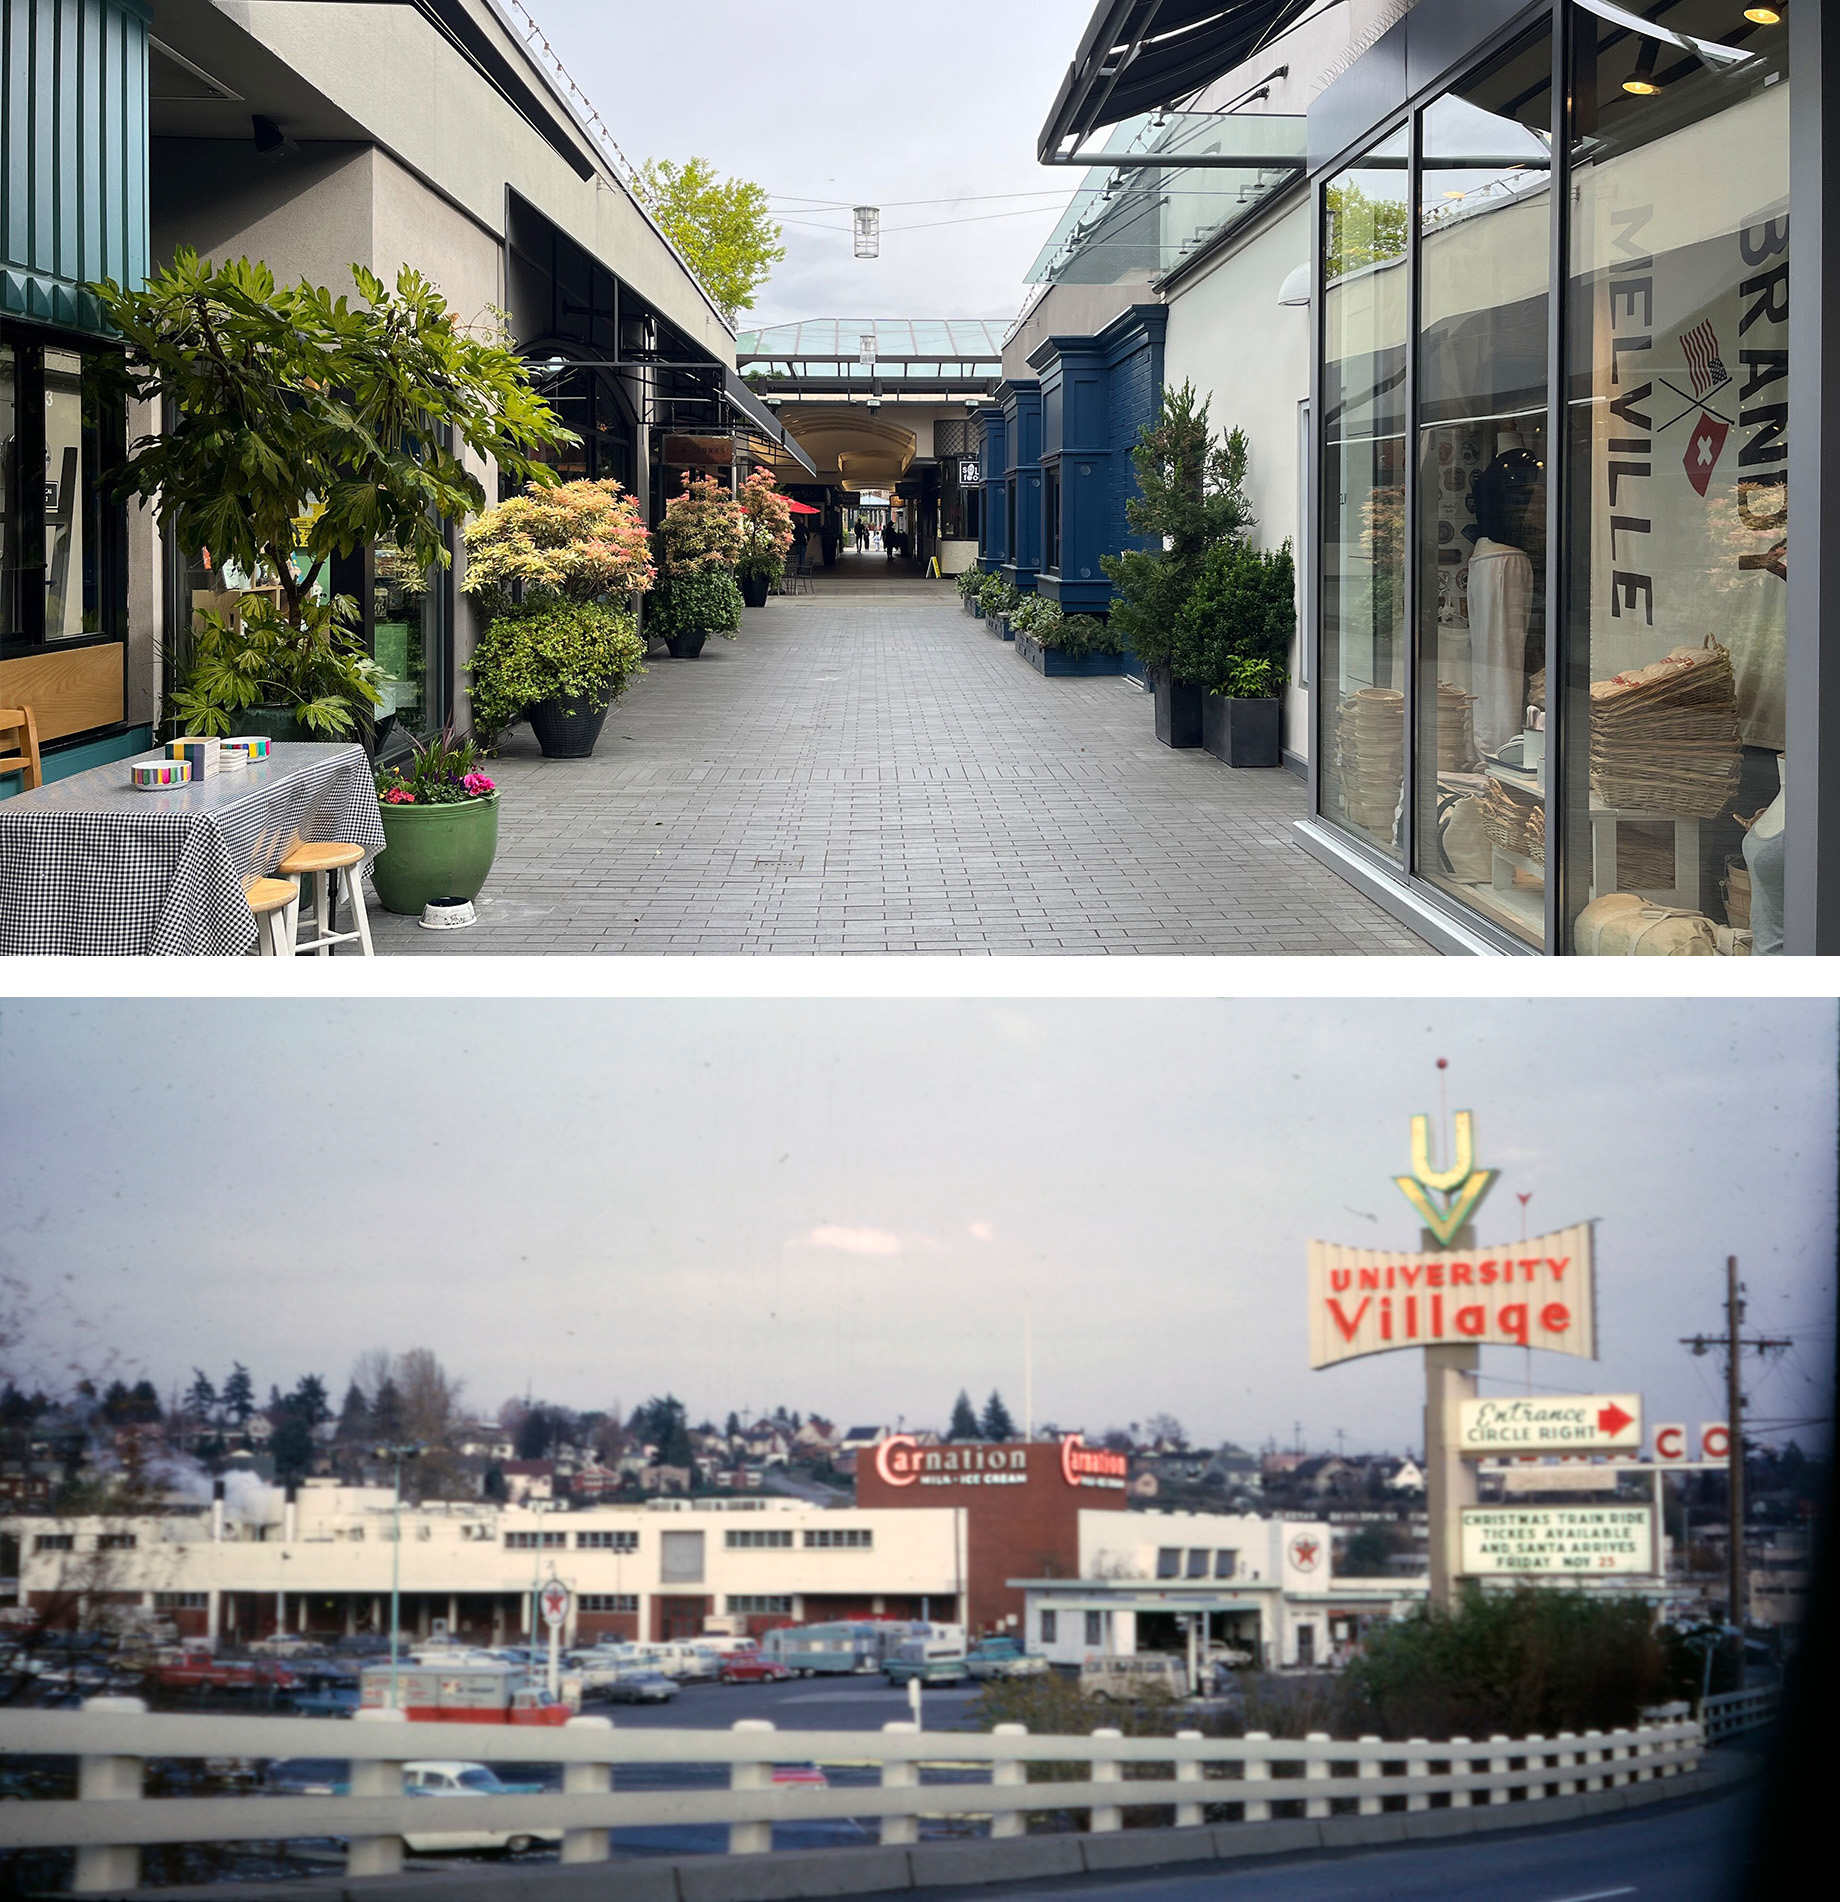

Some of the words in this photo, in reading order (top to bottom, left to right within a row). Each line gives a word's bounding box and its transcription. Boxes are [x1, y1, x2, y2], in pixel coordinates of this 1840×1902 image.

[1738, 197, 1789, 583] BRANDY
[1608, 204, 1654, 626] MELVILLE
[1329, 1256, 1571, 1292] UNIVERSITY
[1325, 1294, 1572, 1346] Village
[1475, 1401, 1587, 1428] Entrance
[1467, 1427, 1531, 1442] CIRCLE
[1539, 1425, 1596, 1440] RIGHT
[876, 1434, 1027, 1486] Carnation
[1061, 1434, 1126, 1486] Carnation
[983, 1472, 1027, 1484] CREAM
[1463, 1514, 1550, 1526] CHRISTMAS
[1558, 1513, 1604, 1525] TRAIN
[1609, 1512, 1645, 1524] RIDE
[1545, 1527, 1632, 1539] AVAILABLE
[1479, 1543, 1511, 1554] AND
[1516, 1542, 1565, 1553] SANTA
[1571, 1541, 1637, 1553] ARRIVES
[1496, 1557, 1550, 1568] FRIDAY
[1562, 1556, 1592, 1568] NOV
[1598, 1556, 1616, 1568] 25
